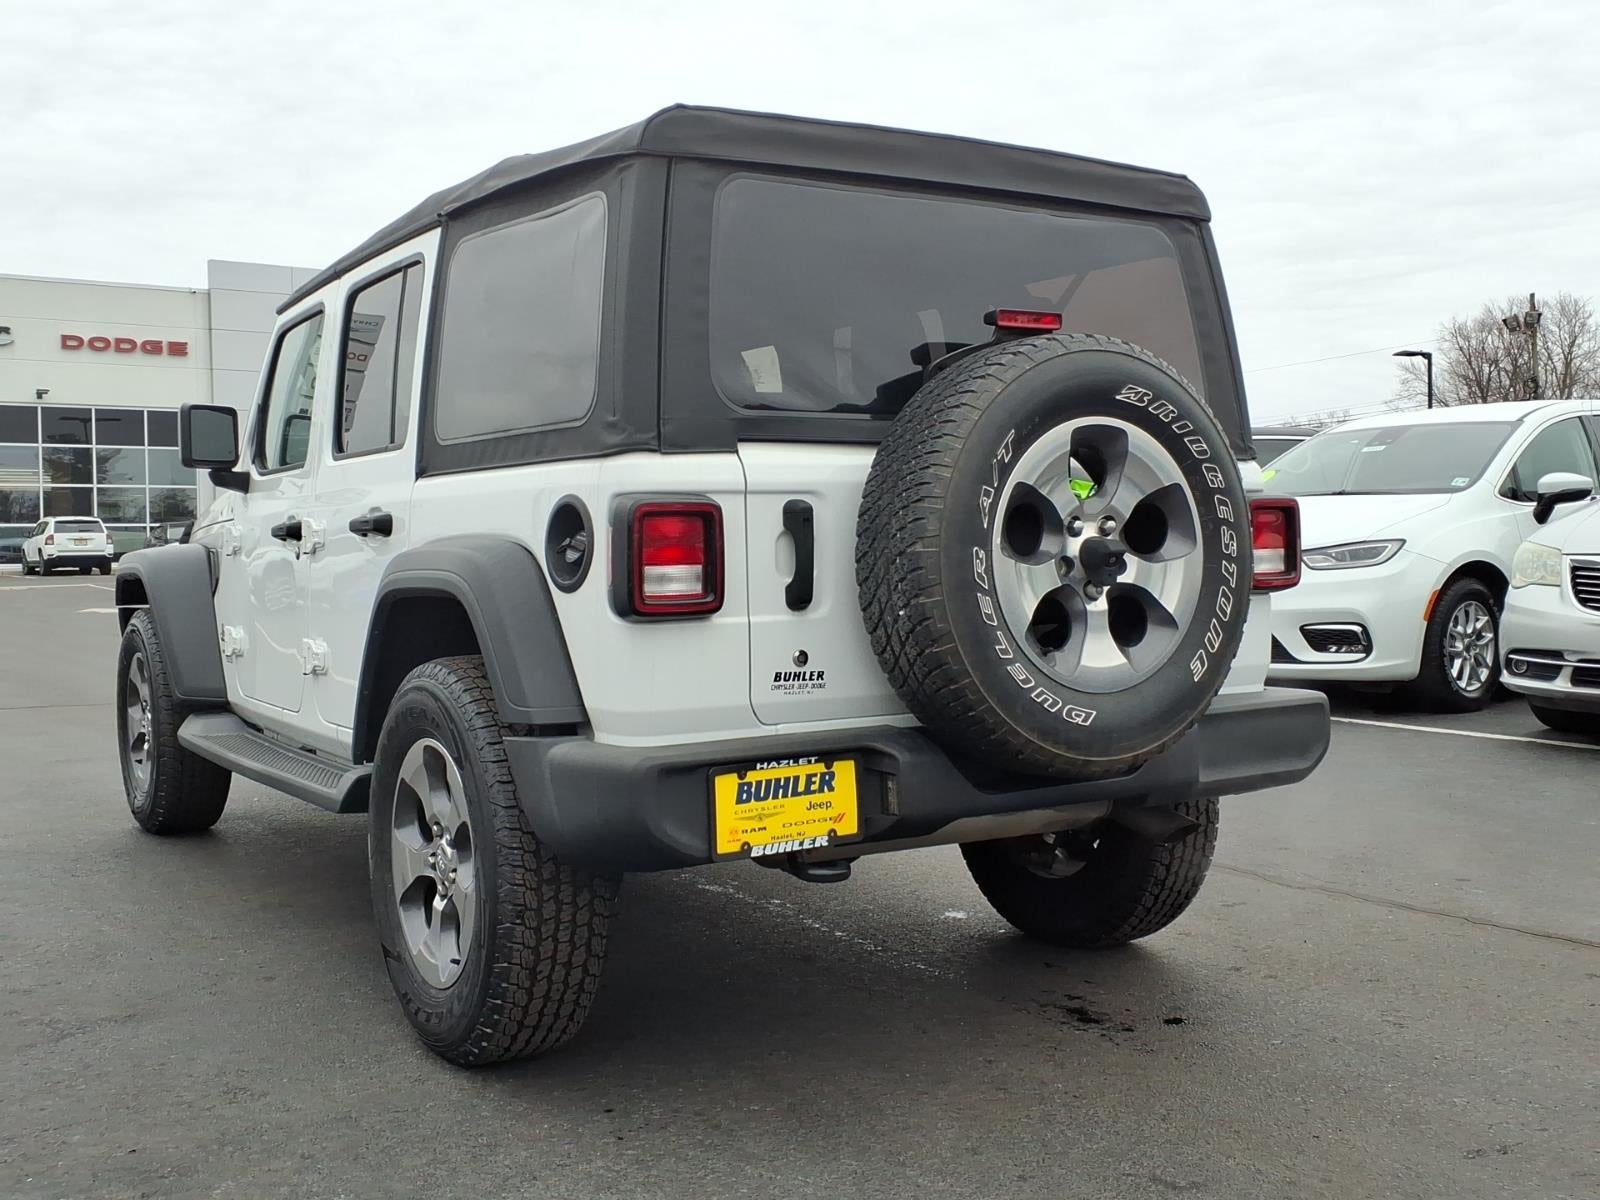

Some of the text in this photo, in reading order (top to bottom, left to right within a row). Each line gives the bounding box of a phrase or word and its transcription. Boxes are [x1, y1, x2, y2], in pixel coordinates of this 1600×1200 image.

[61, 334, 188, 356] DODGE
[1115, 384, 1238, 682] BRIDGESTONE
[973, 429, 1097, 726] DUELER A/T
[774, 671, 825, 682] BUHLER
[756, 757, 818, 770] HAZLET
[735, 771, 836, 805] BUHLER
[734, 804, 785, 815] CHRYSLER
[806, 801, 832, 811] Jeep
[782, 817, 836, 828] DODGE
[741, 826, 767, 834] RAM
[750, 835, 829, 857] BUHLER
